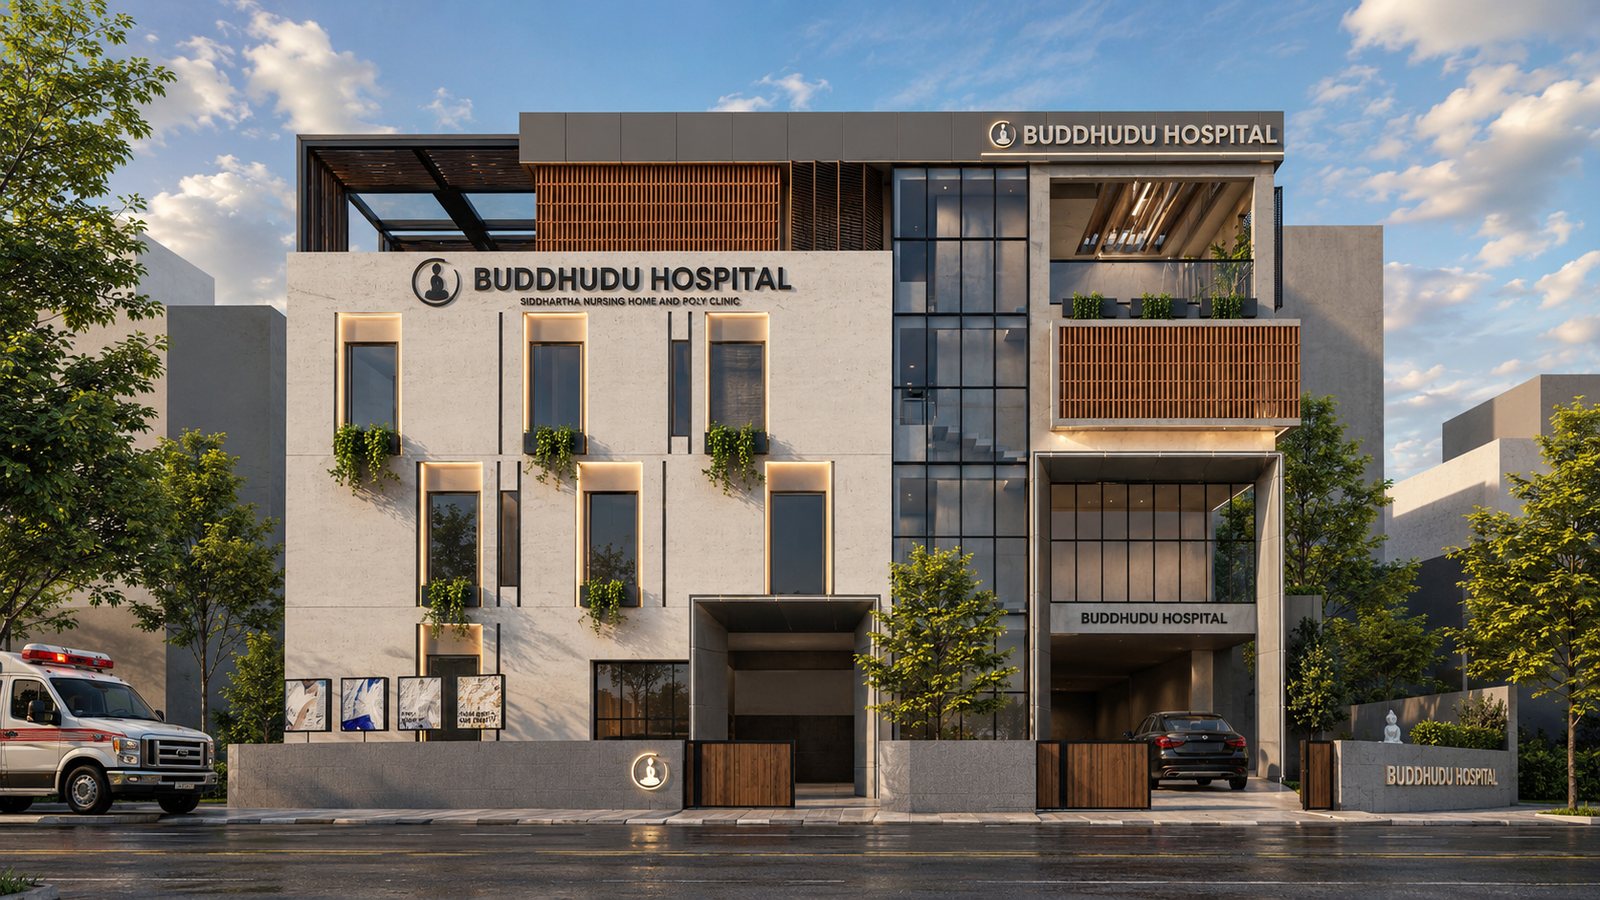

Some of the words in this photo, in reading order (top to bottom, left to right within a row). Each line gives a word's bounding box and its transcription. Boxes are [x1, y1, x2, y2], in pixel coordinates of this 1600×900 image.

[1023, 125, 1156, 145] BUDDHUDU
[1164, 124, 1278, 144] HOSPITAL
[474, 267, 640, 291] BUDDHUDU
[651, 267, 792, 291] HOSPITAL
[520, 297, 581, 306] SIDDHARTHA
[583, 297, 625, 306] NURSING
[628, 297, 657, 306] HOME
[659, 297, 680, 306] AND
[709, 297, 740, 306] CLINIC
[1081, 612, 1158, 624] BUDDHUDU
[1162, 612, 1228, 624] HOSPITAL
[1386, 765, 1453, 786] BUDDHUDU
[1455, 767, 1498, 786] HOSPITAL
